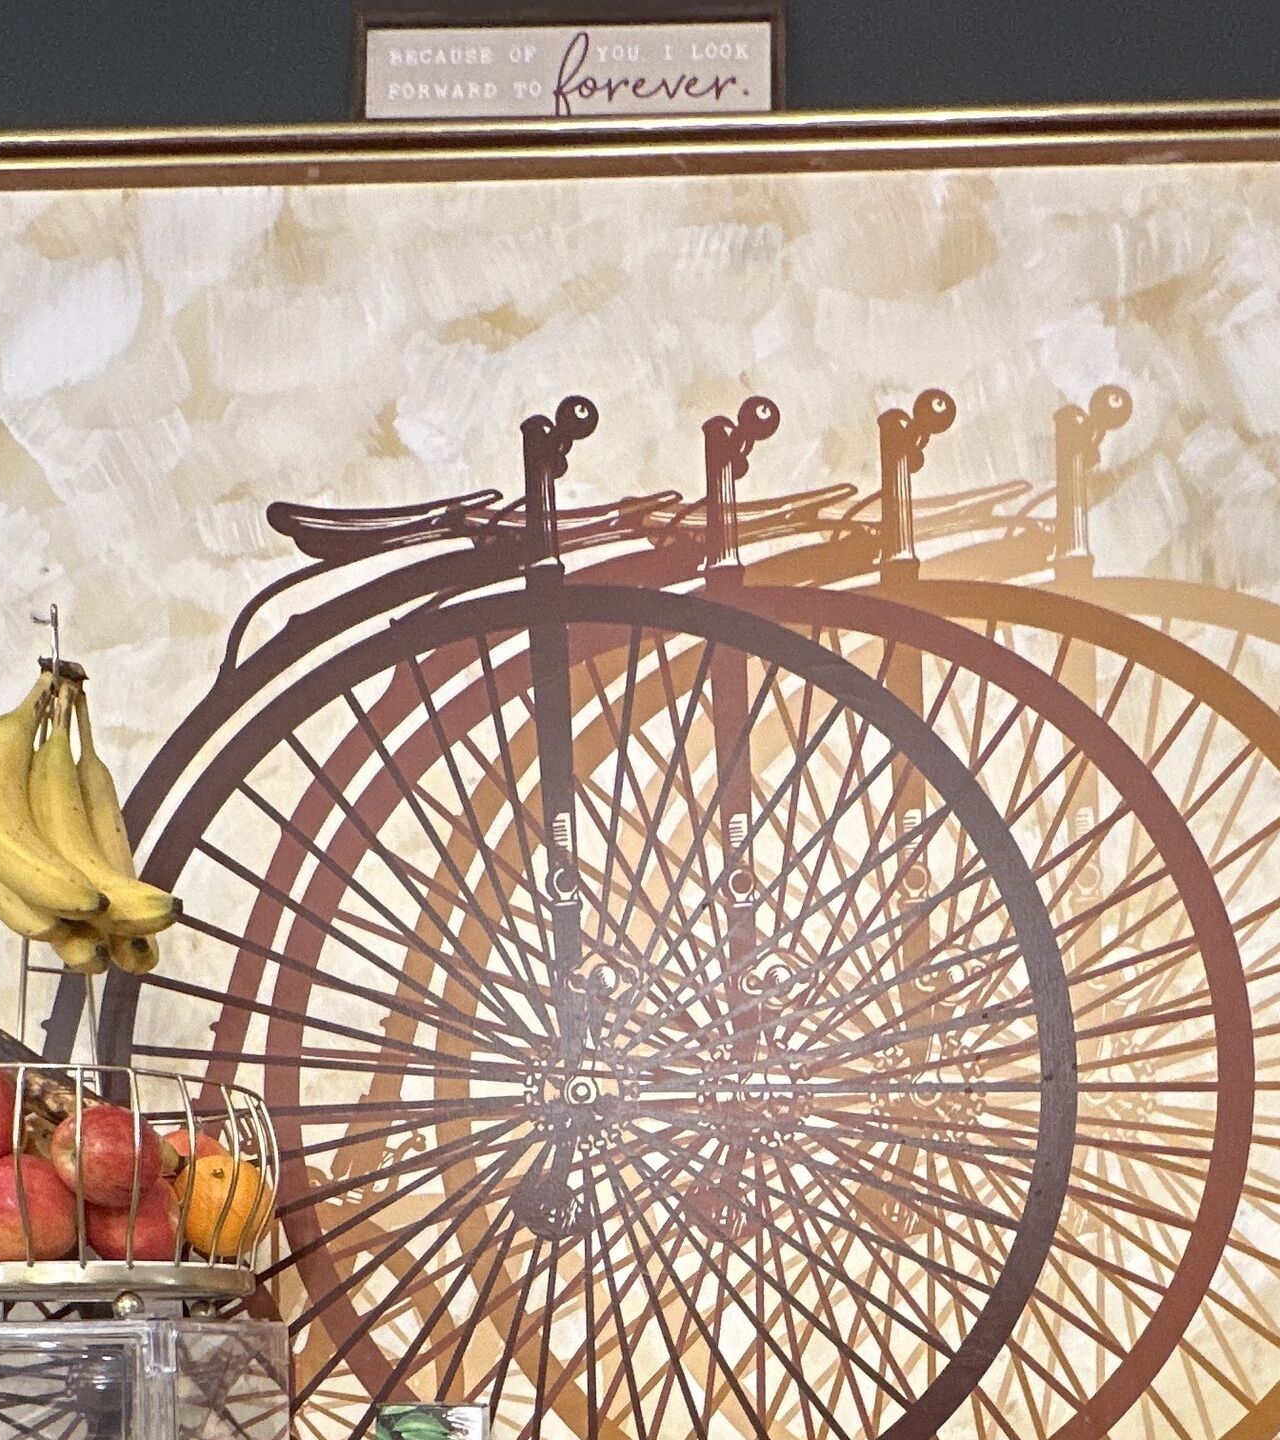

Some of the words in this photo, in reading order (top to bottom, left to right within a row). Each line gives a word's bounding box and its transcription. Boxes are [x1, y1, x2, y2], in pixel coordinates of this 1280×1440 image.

[388, 82, 498, 101] FORWARD
[514, 82, 542, 98] TO
[553, 32, 750, 117] forever.
[389, 48, 493, 67] BECAUSE
[510, 47, 537, 63] OF
[596, 45, 641, 63] YOU
[663, 45, 673, 61] I
[692, 43, 750, 61] LOOK
